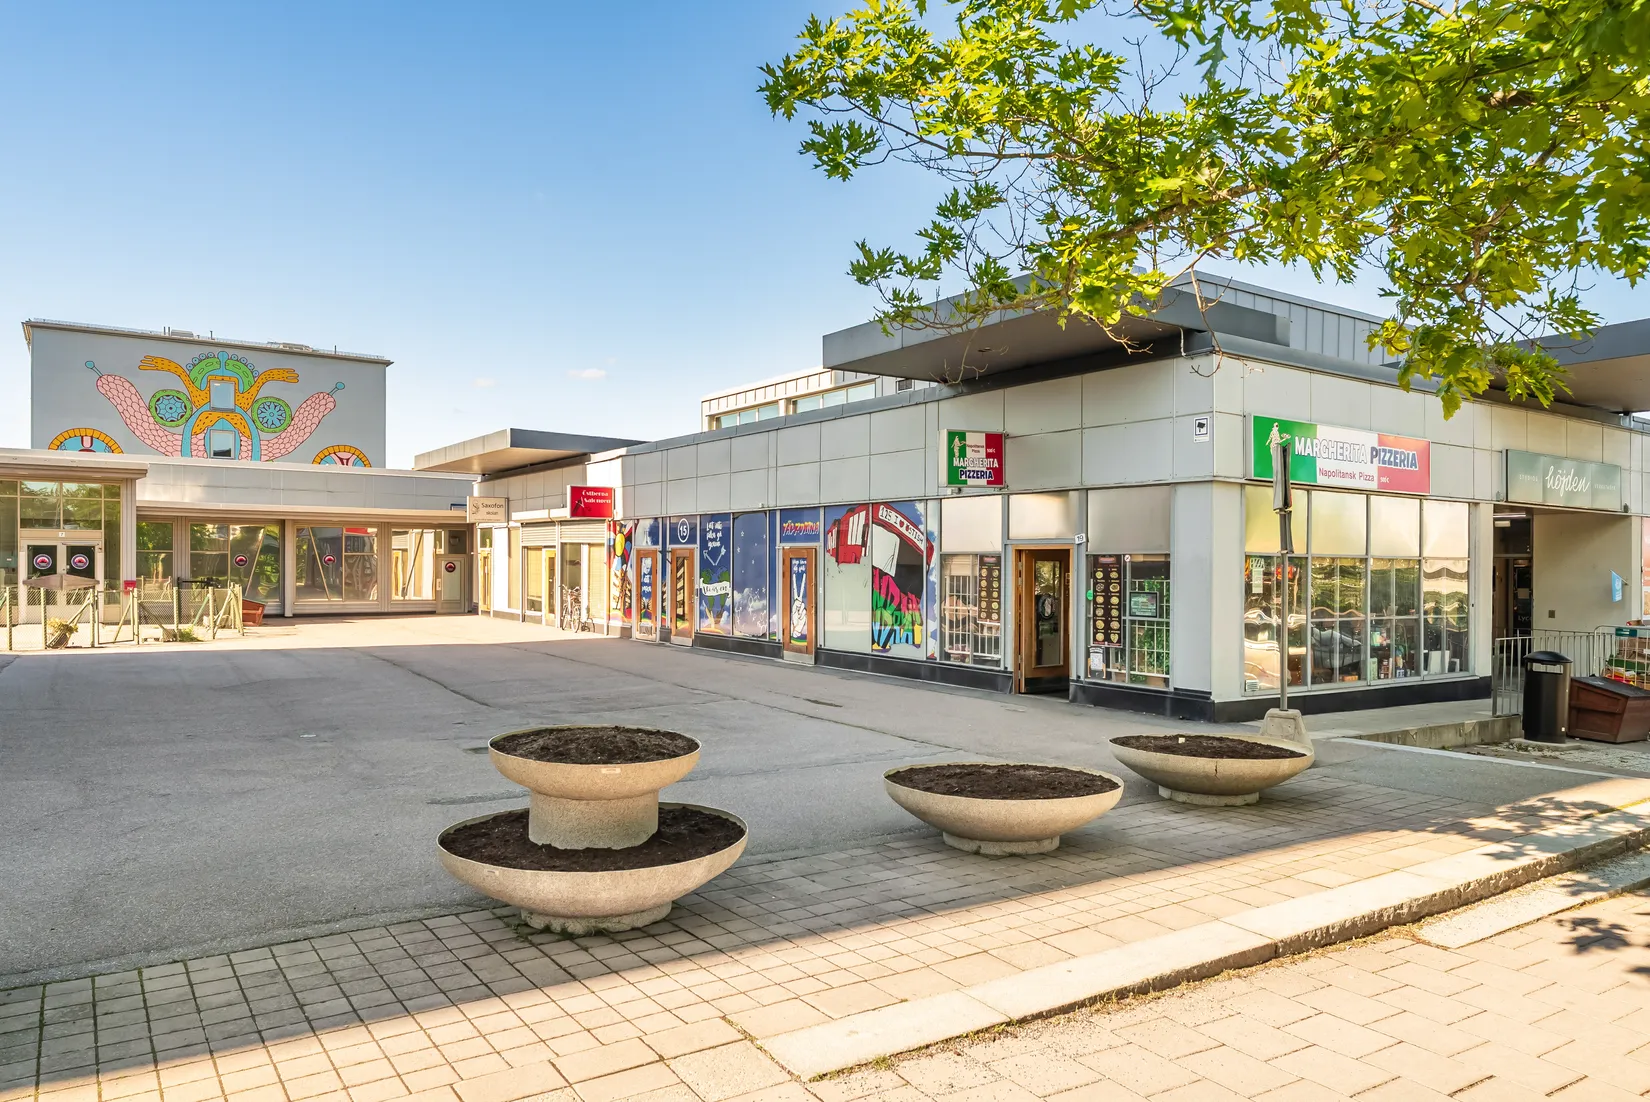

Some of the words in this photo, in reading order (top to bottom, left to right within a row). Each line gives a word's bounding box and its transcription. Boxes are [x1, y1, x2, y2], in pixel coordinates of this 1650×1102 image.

[1295, 435, 1368, 465] MARGHERITA
[1370, 446, 1419, 470] PIZZERIA
[953, 457, 999, 468] MARGHERITA
[959, 469, 994, 480] PIZZERIA
[1319, 467, 1356, 480] Napolitansk
[1358, 471, 1375, 482] Pizza
[1545, 465, 1591, 497] höjden
[880, 506, 892, 521] 125
[680, 525, 687, 537] 15
